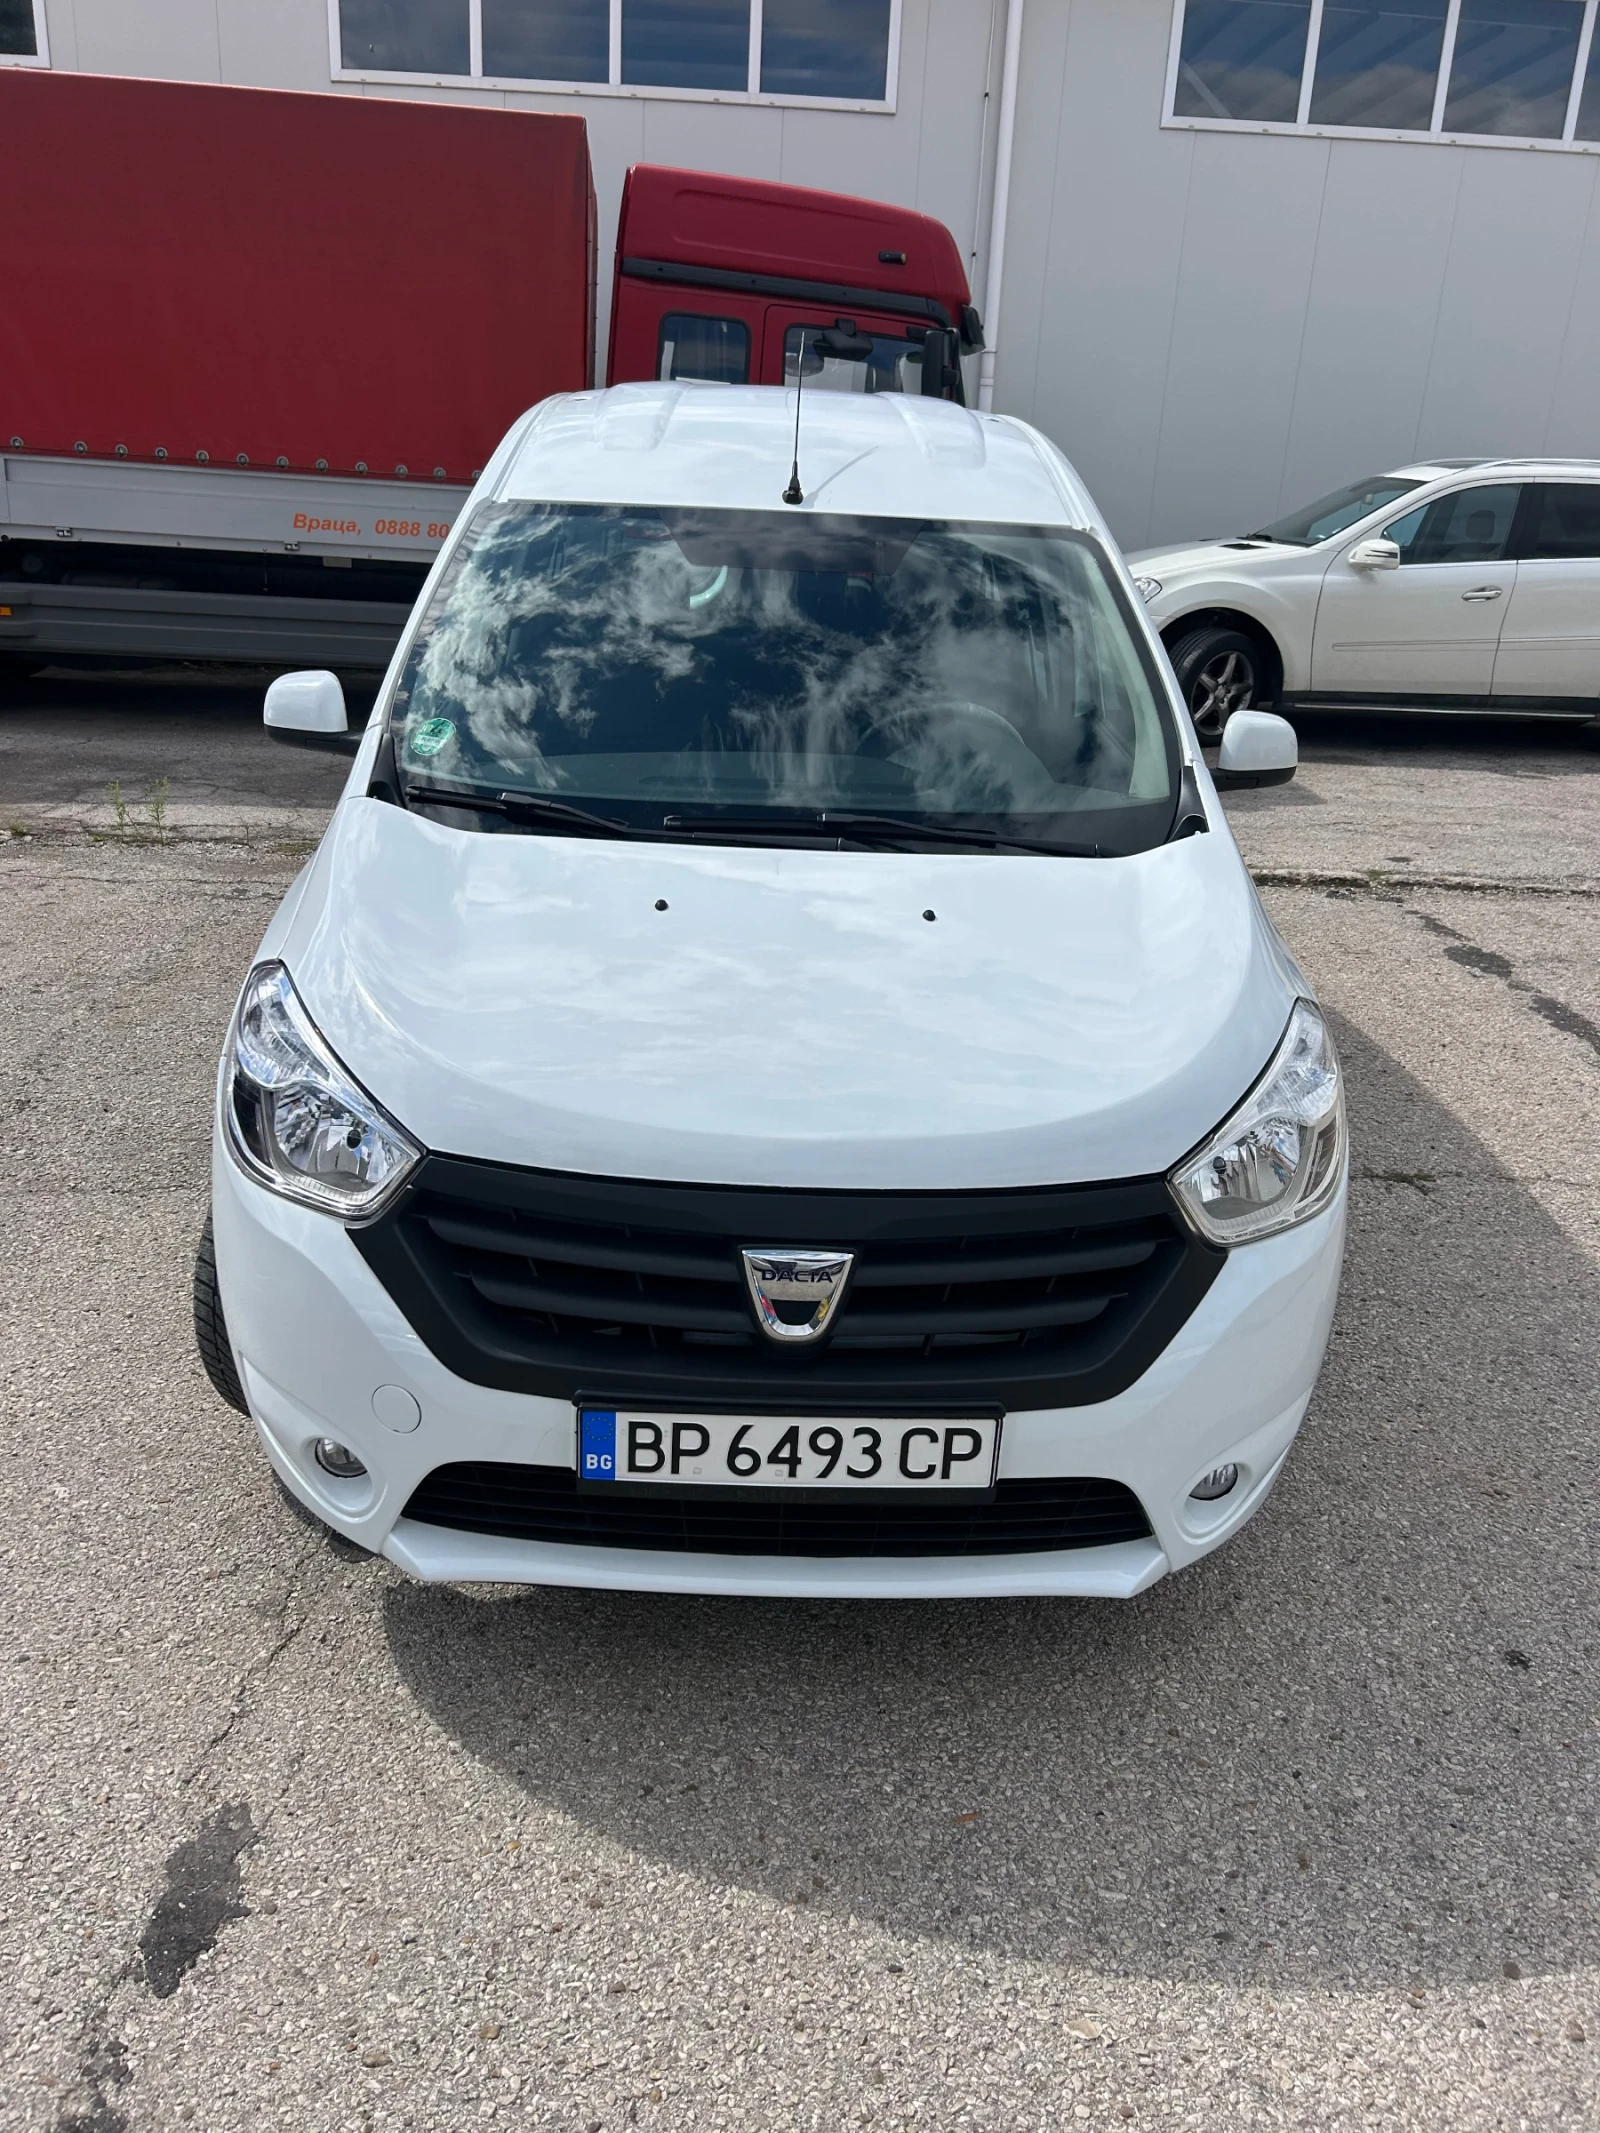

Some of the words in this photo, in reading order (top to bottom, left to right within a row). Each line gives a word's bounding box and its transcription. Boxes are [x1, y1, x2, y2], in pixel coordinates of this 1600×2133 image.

[293, 512, 362, 536] Враца,
[375, 518, 421, 537] 0888
[761, 1269, 833, 1283] DACIA
[627, 1420, 710, 1475] BP
[726, 1424, 882, 1479] 6493
[899, 1427, 983, 1480] CP
[586, 1453, 613, 1471] BG
